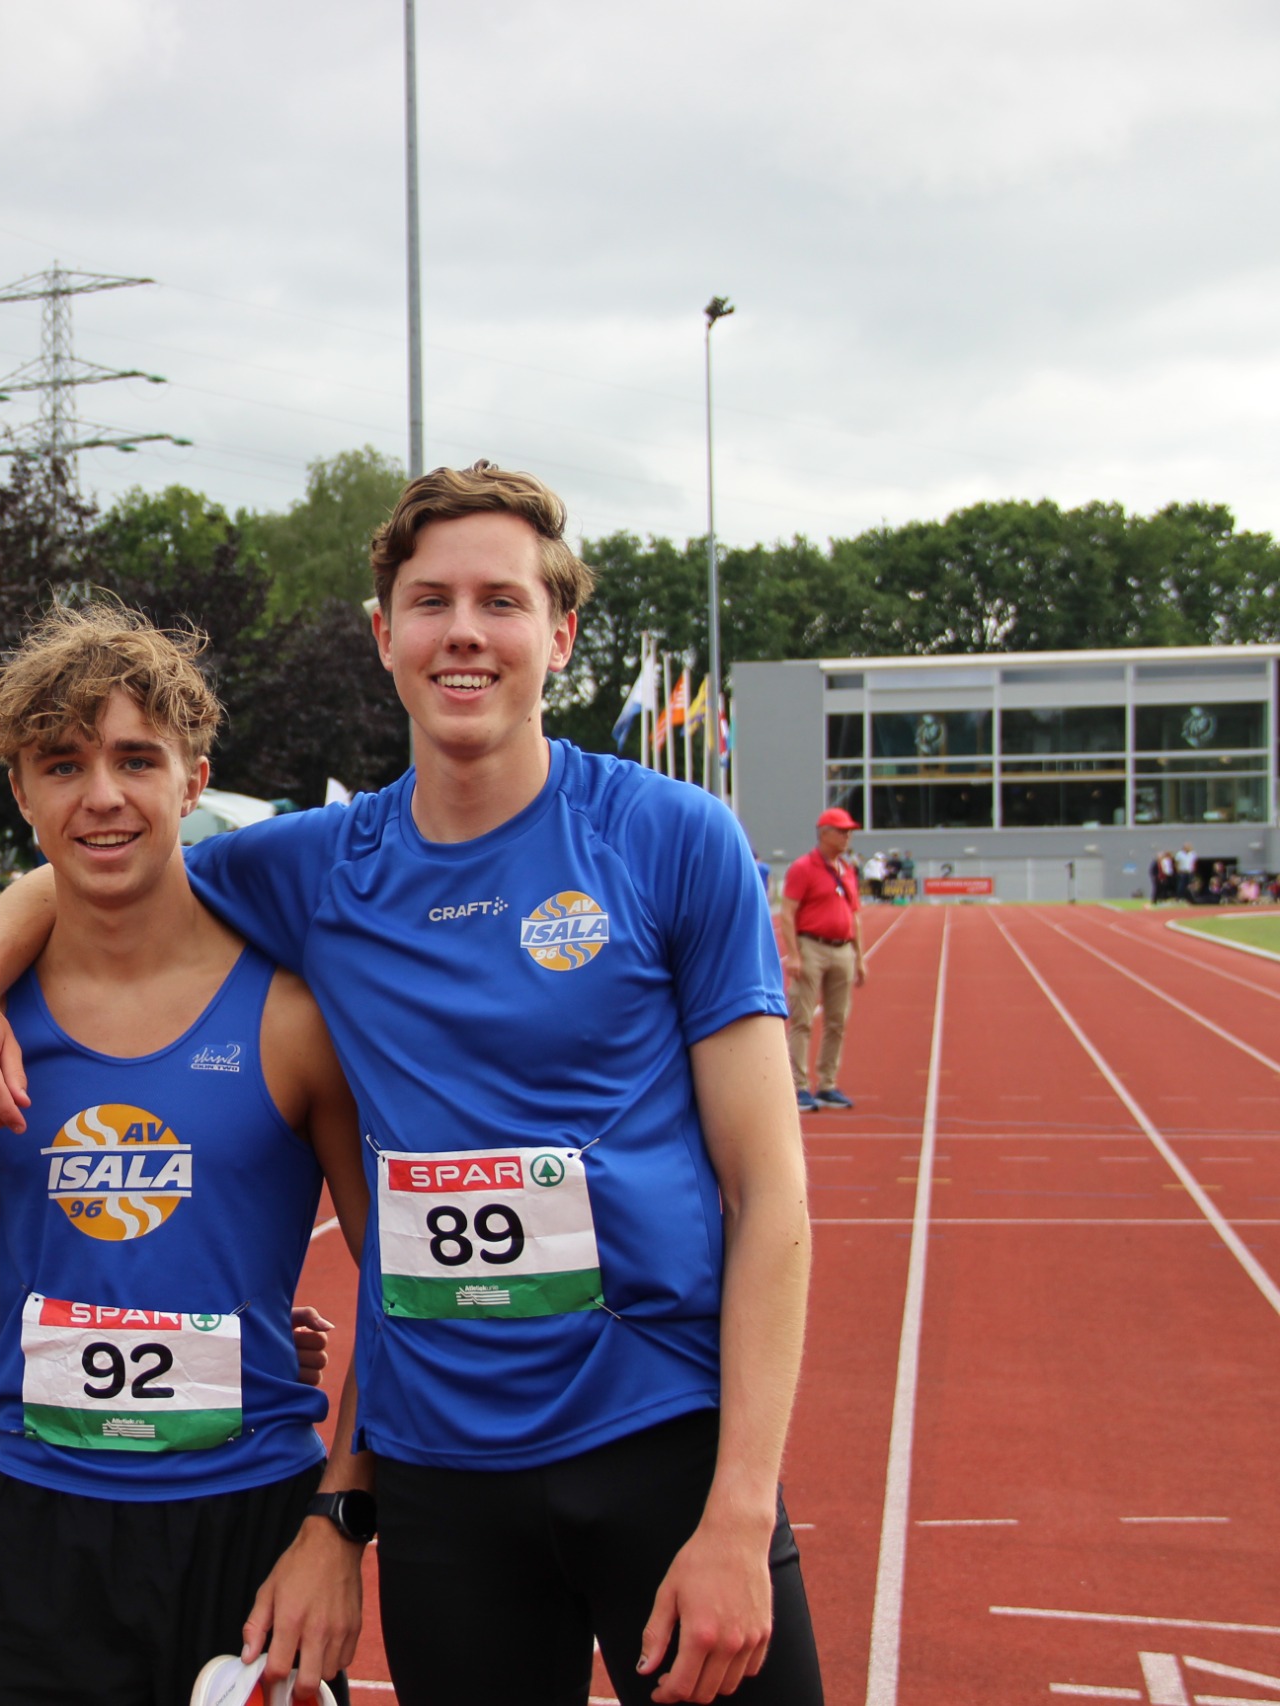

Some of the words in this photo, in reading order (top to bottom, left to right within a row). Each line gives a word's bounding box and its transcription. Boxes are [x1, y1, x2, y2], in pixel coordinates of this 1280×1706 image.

[428, 901, 493, 922] CRAFT
[569, 899, 595, 914] AV
[522, 917, 609, 944] ISALA
[534, 947, 558, 961] 96
[121, 1122, 170, 1144] AV
[47, 1153, 193, 1191] ISALA
[410, 1161, 521, 1188] SPAR
[68, 1200, 104, 1219] 96
[426, 1203, 525, 1267] 89
[70, 1302, 180, 1325] SPAR
[81, 1341, 175, 1400] 92
